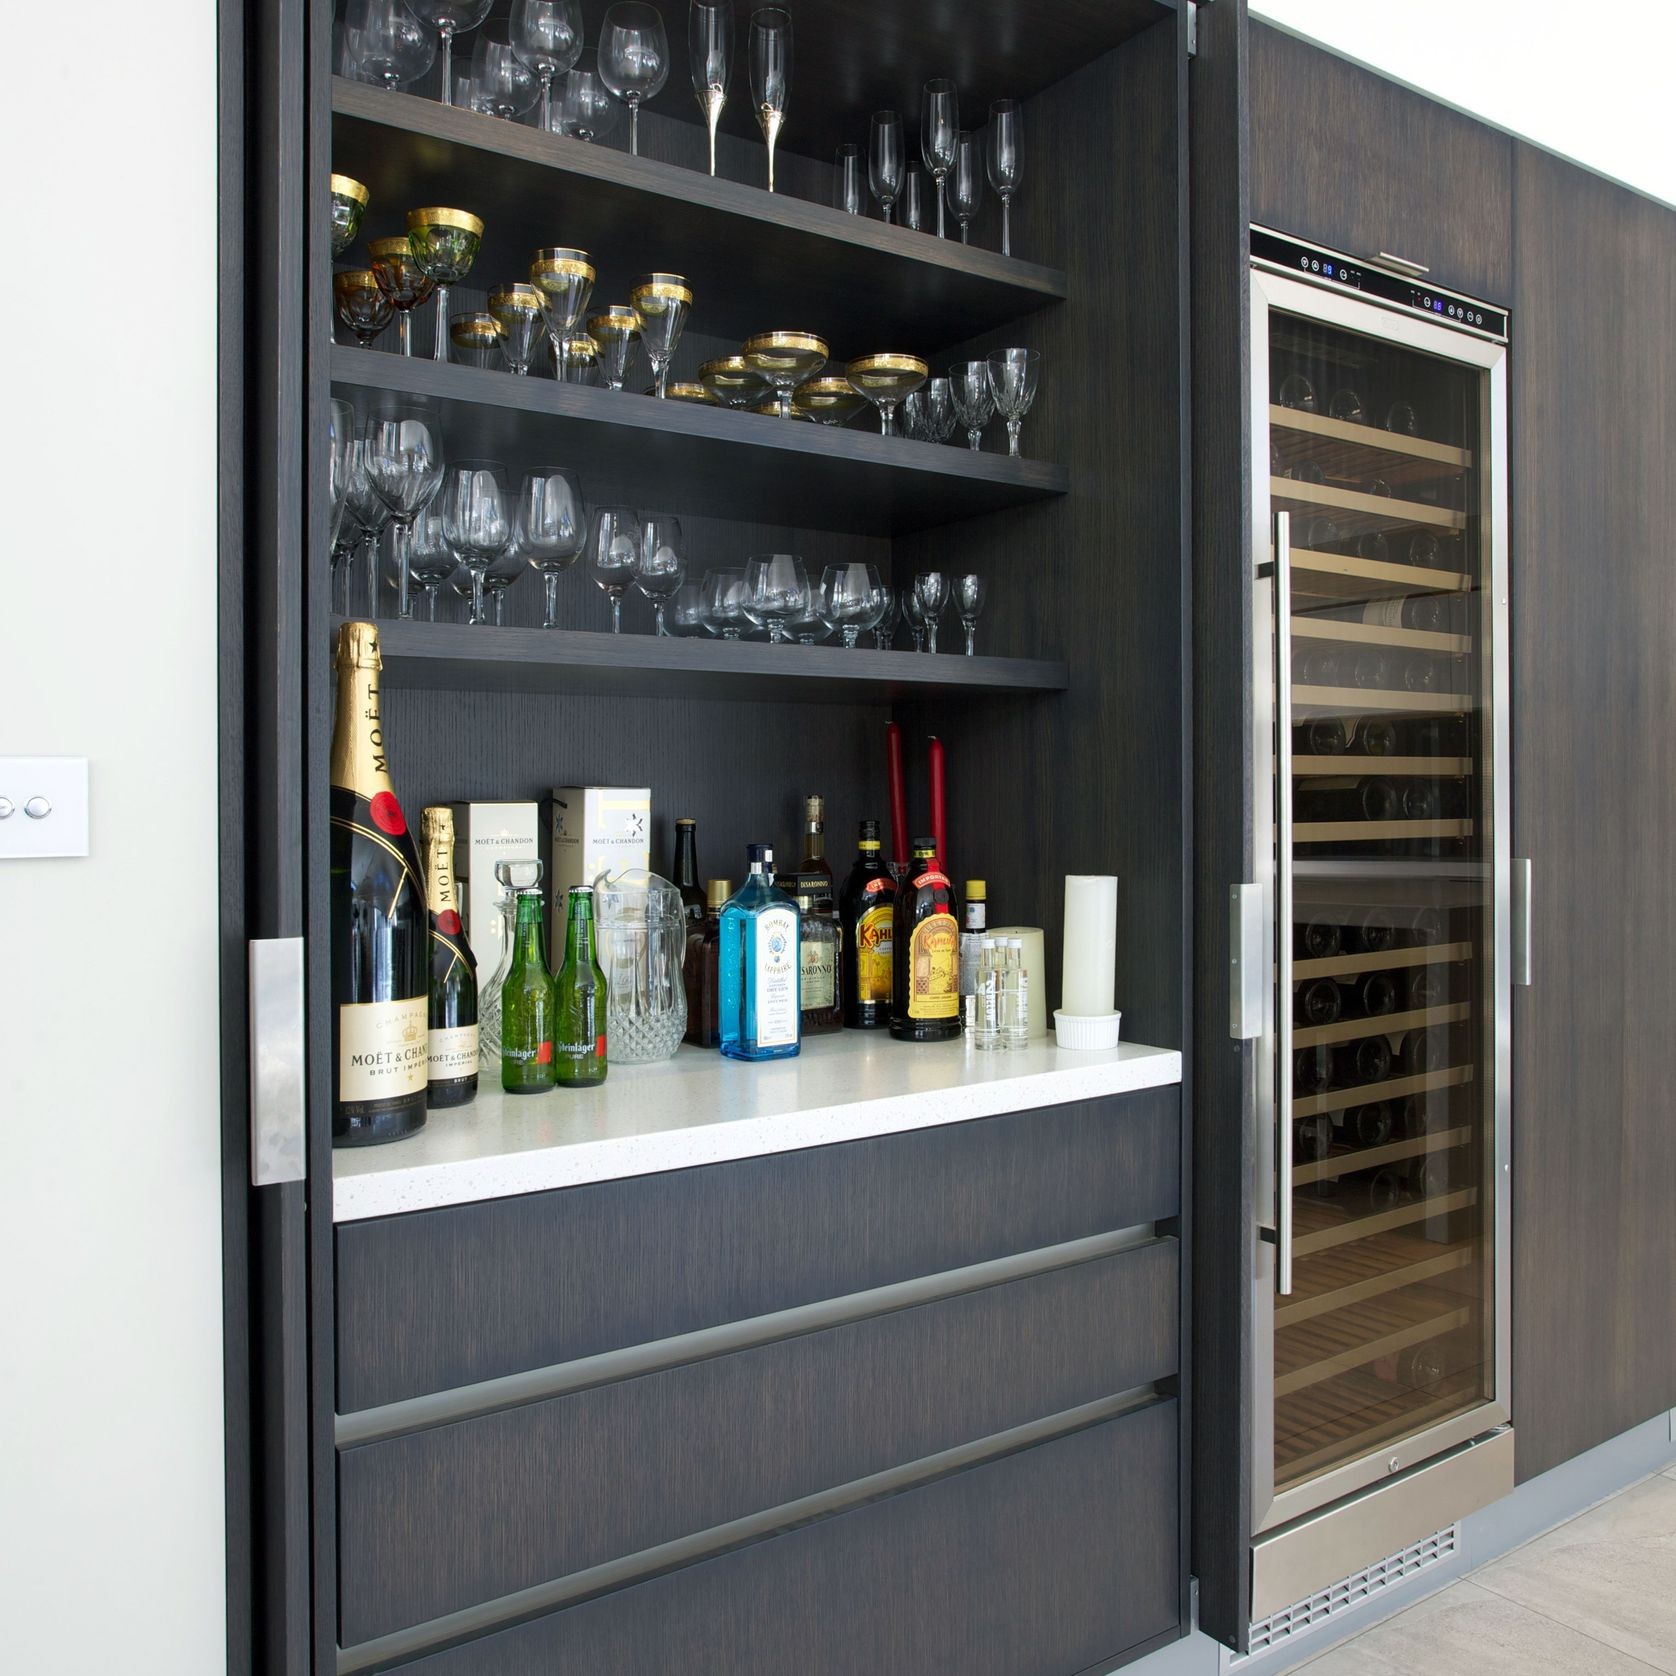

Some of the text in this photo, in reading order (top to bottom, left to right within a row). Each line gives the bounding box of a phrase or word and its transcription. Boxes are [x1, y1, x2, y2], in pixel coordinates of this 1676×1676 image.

[365, 684, 388, 774] MOËT
[434, 849, 450, 902] MOËT
[764, 919, 790, 930] BOMBAY
[351, 1051, 393, 1066] MOËT
[395, 1053, 402, 1062] &
[370, 1066, 398, 1076] BRUT
